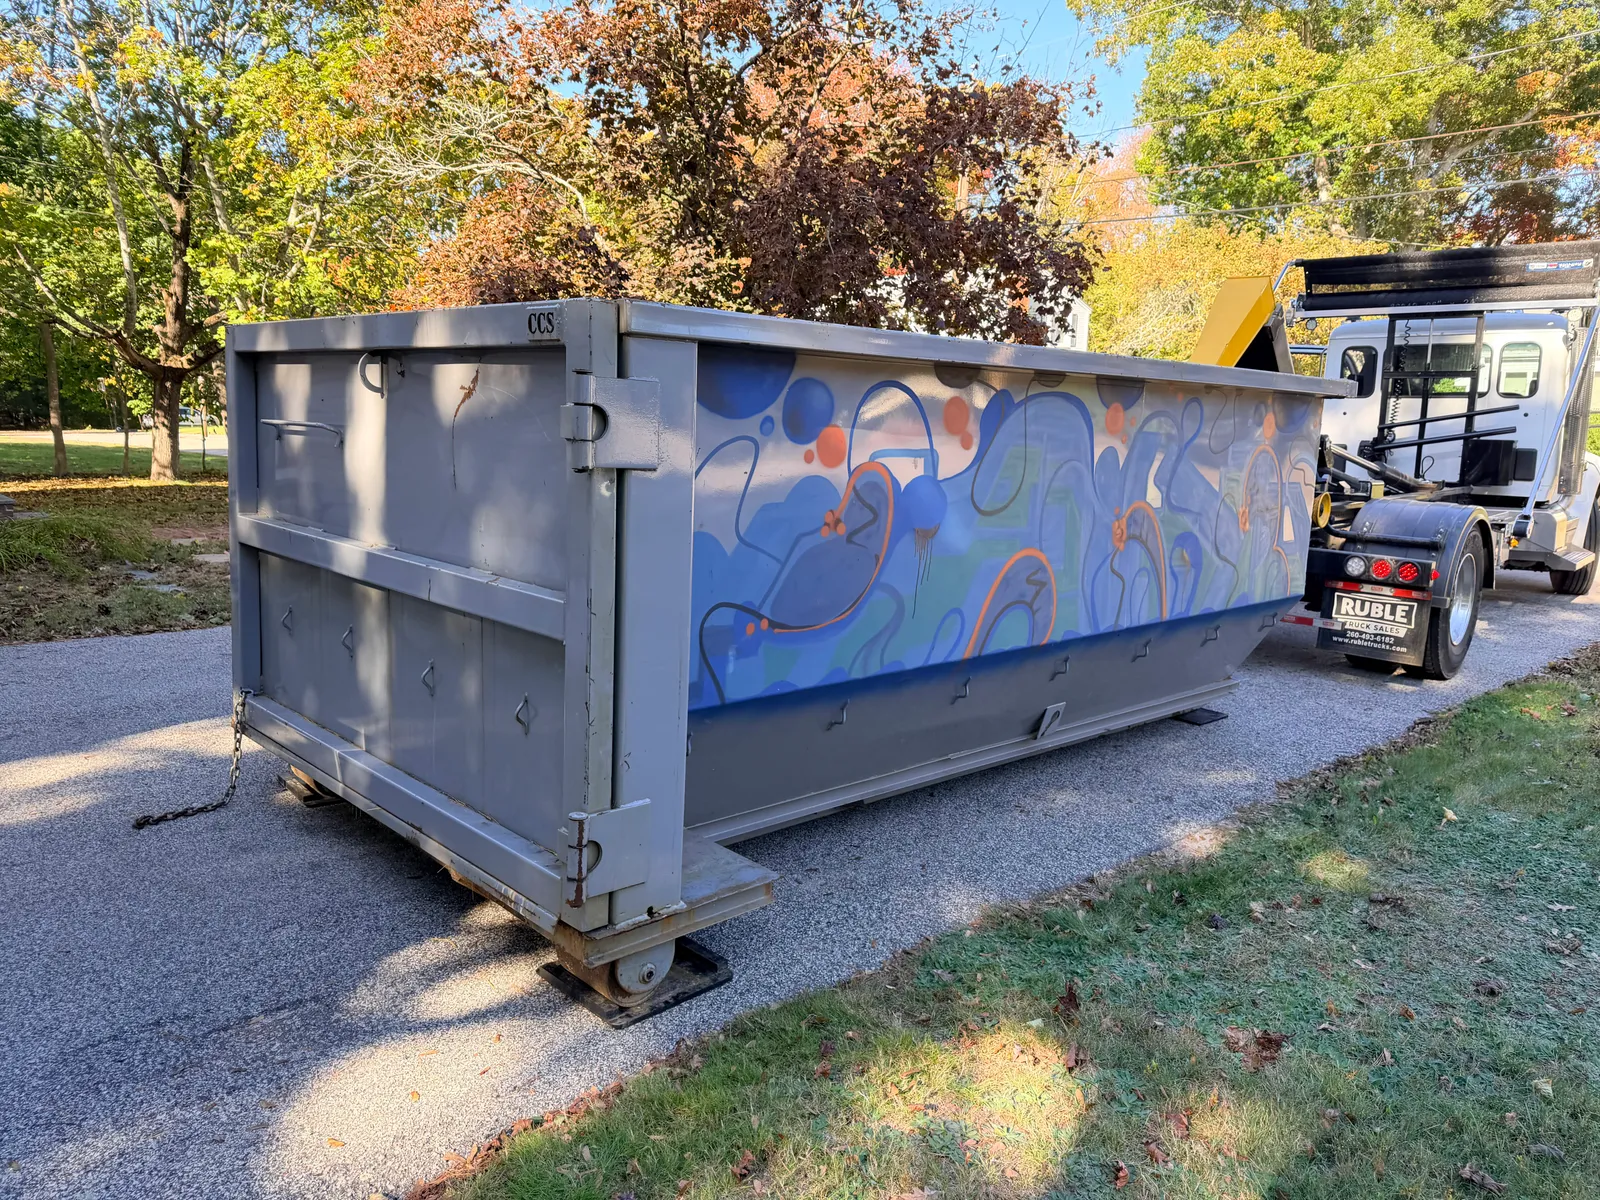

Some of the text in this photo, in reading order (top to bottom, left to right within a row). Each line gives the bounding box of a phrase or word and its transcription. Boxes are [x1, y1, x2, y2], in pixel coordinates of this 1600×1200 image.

[528, 312, 555, 334] CCS
[1341, 597, 1409, 623] RUBLE
[1346, 631, 1394, 643] 260-493-6182
[1373, 624, 1400, 634] SALES
[1332, 636, 1407, 652] www.rubletrucks.com
